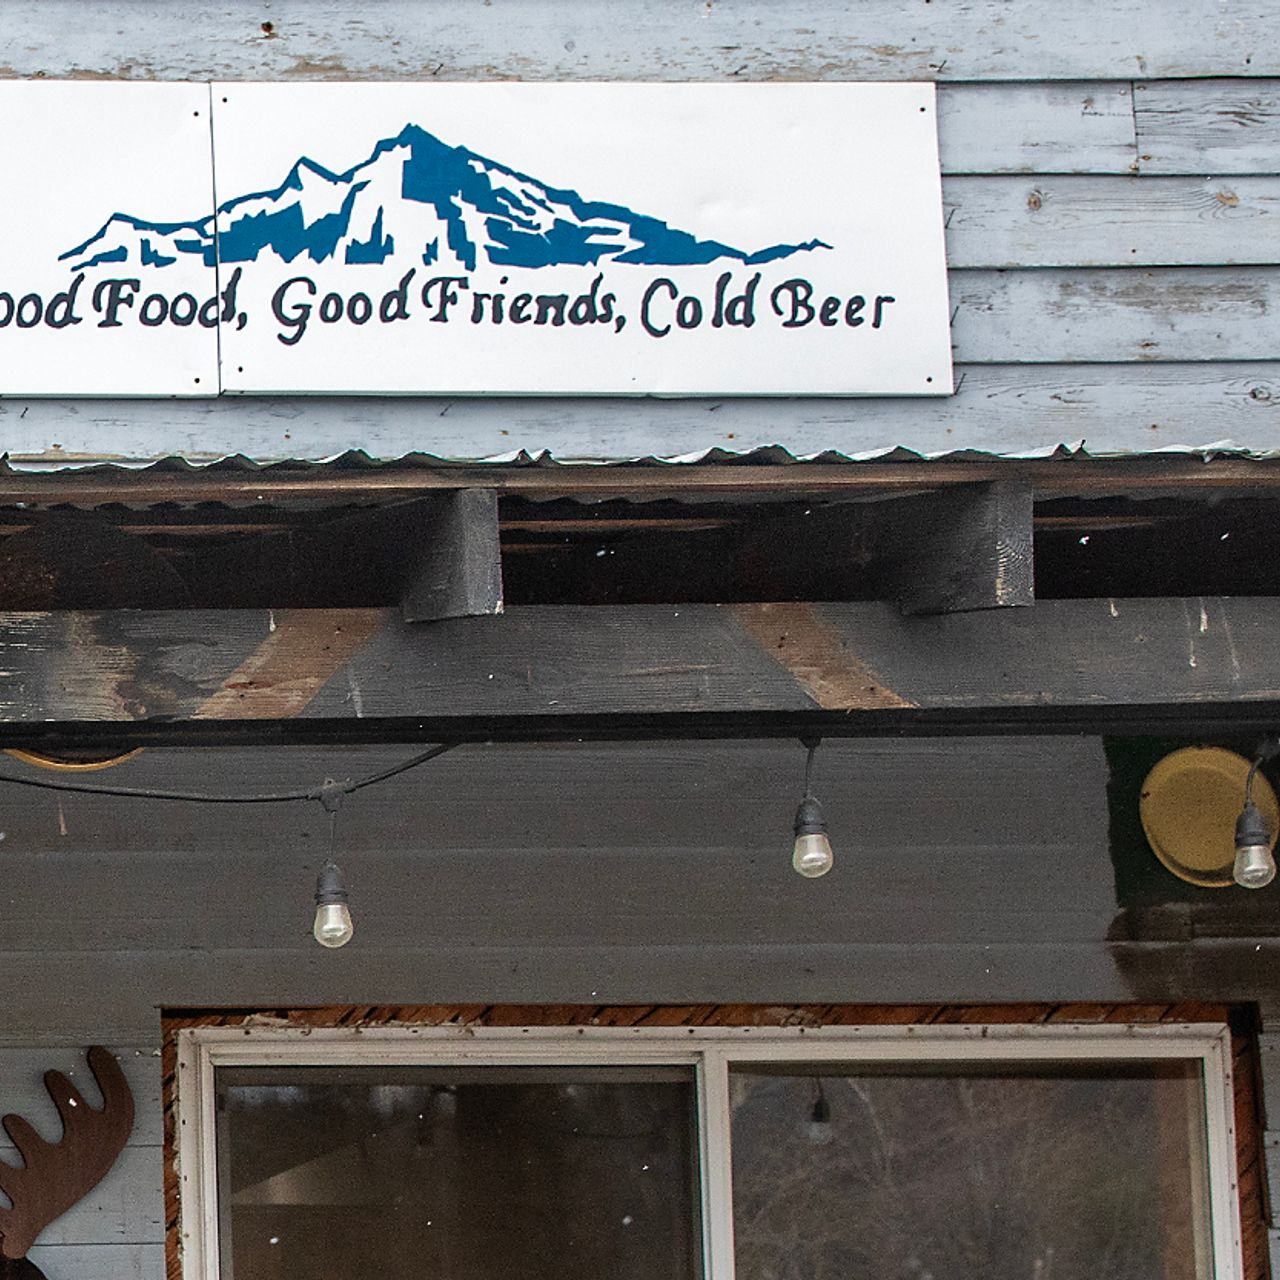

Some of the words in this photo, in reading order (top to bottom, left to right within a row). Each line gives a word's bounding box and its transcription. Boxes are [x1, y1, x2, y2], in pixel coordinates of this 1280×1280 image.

[93, 267, 247, 331] Food,
[272, 268, 416, 346] Good
[422, 273, 626, 334] Friends,
[641, 272, 761, 337] Cold
[771, 279, 896, 328] Beer
